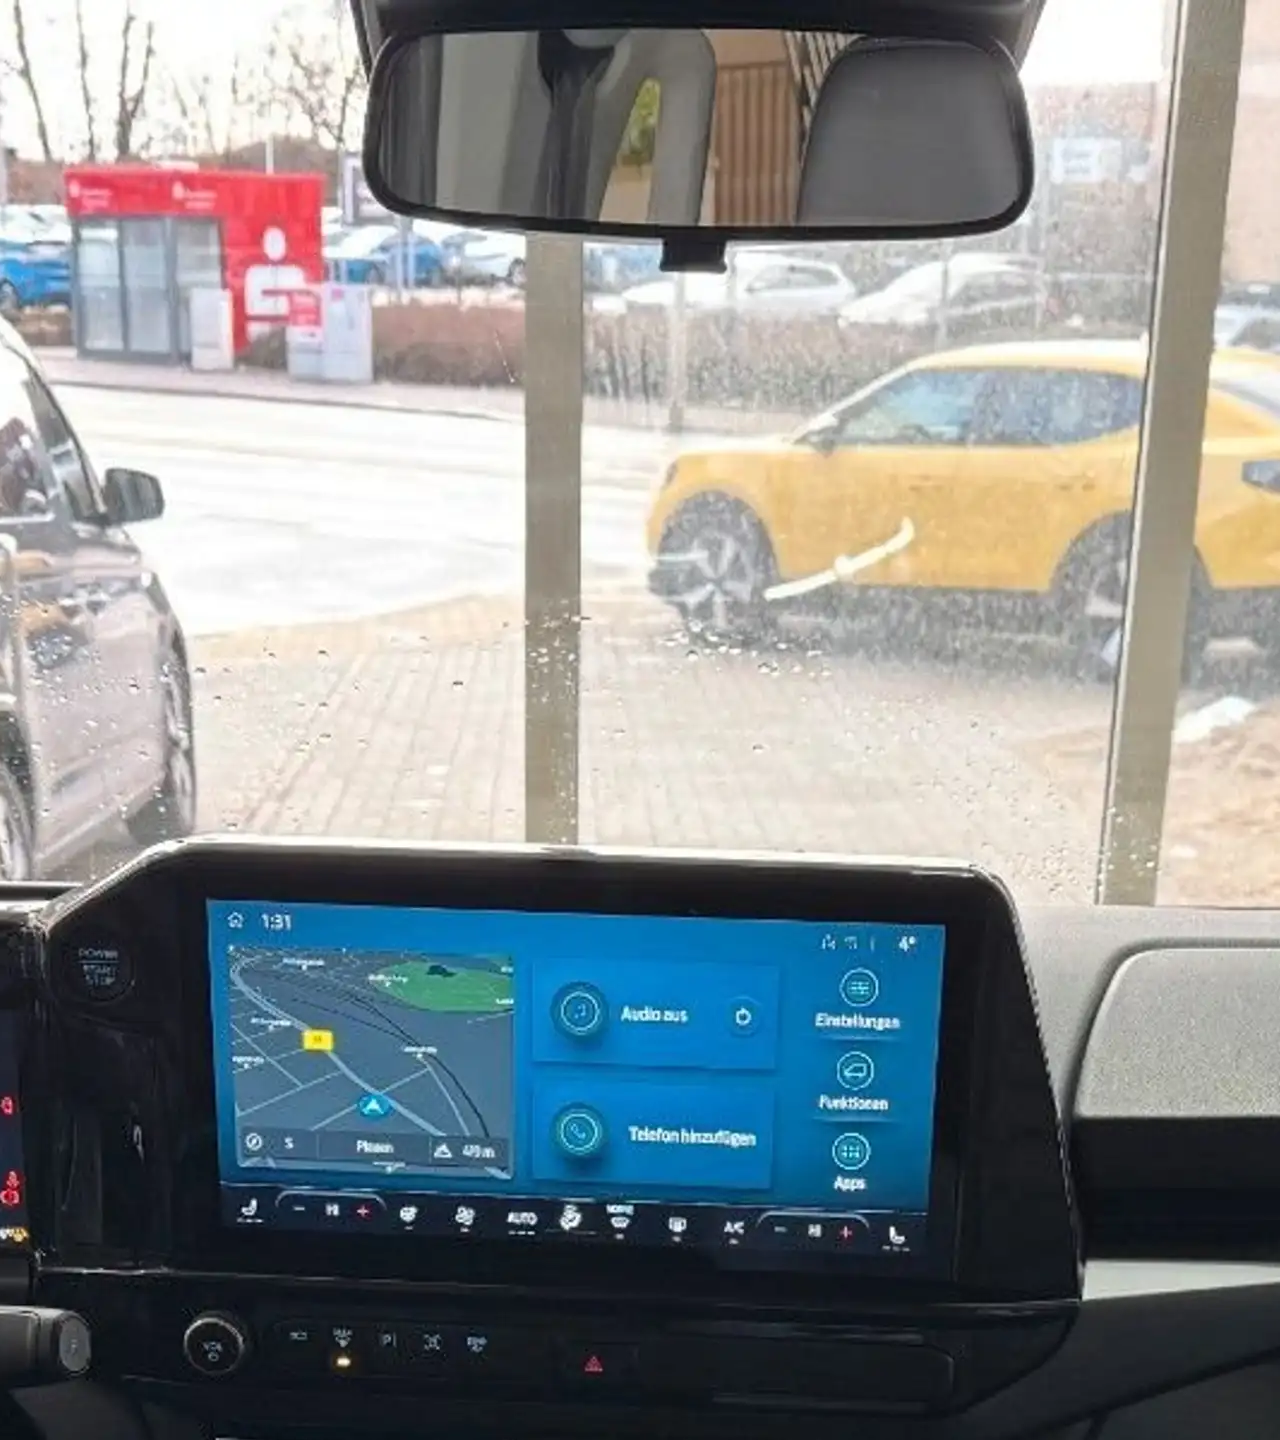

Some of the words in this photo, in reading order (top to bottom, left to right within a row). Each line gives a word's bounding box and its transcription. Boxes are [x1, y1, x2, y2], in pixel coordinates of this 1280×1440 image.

[261, 913, 292, 930] 1:31
[621, 1005, 661, 1023] Audio
[663, 1009, 689, 1024] aus
[815, 1012, 901, 1031] Einstellungen
[818, 1094, 889, 1112] Funktionen
[628, 1125, 680, 1143] Telefon
[681, 1127, 757, 1148] hinzufügen
[833, 1176, 868, 1193] Apps
[506, 1212, 539, 1226] AUTO
